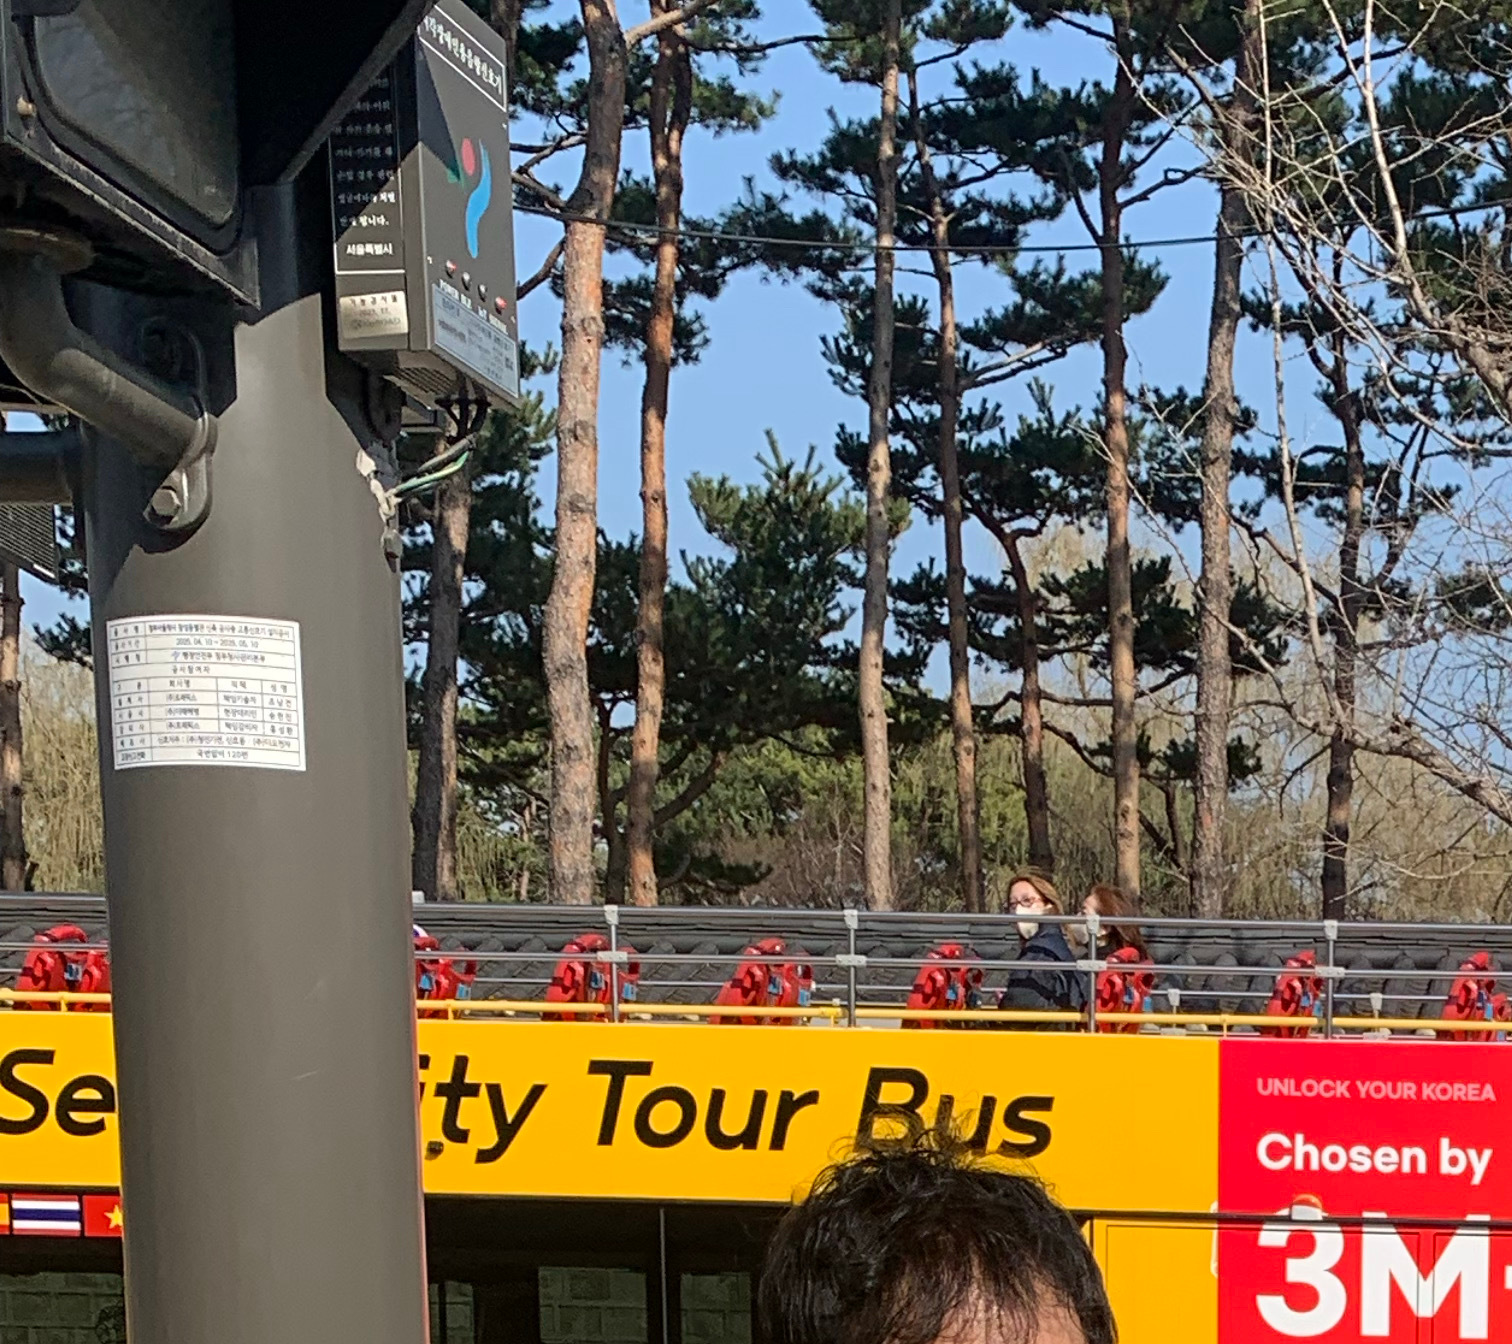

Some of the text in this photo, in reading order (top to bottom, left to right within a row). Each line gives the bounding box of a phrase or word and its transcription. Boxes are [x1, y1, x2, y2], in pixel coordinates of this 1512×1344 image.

[0, 1049, 118, 1137] Se
[587, 1059, 820, 1152] Tour
[853, 1066, 1055, 1159] Bus
[1256, 1077, 1497, 1102] UNLOCK YOUR KOREA
[1256, 1131, 1493, 1185] Chosen by
